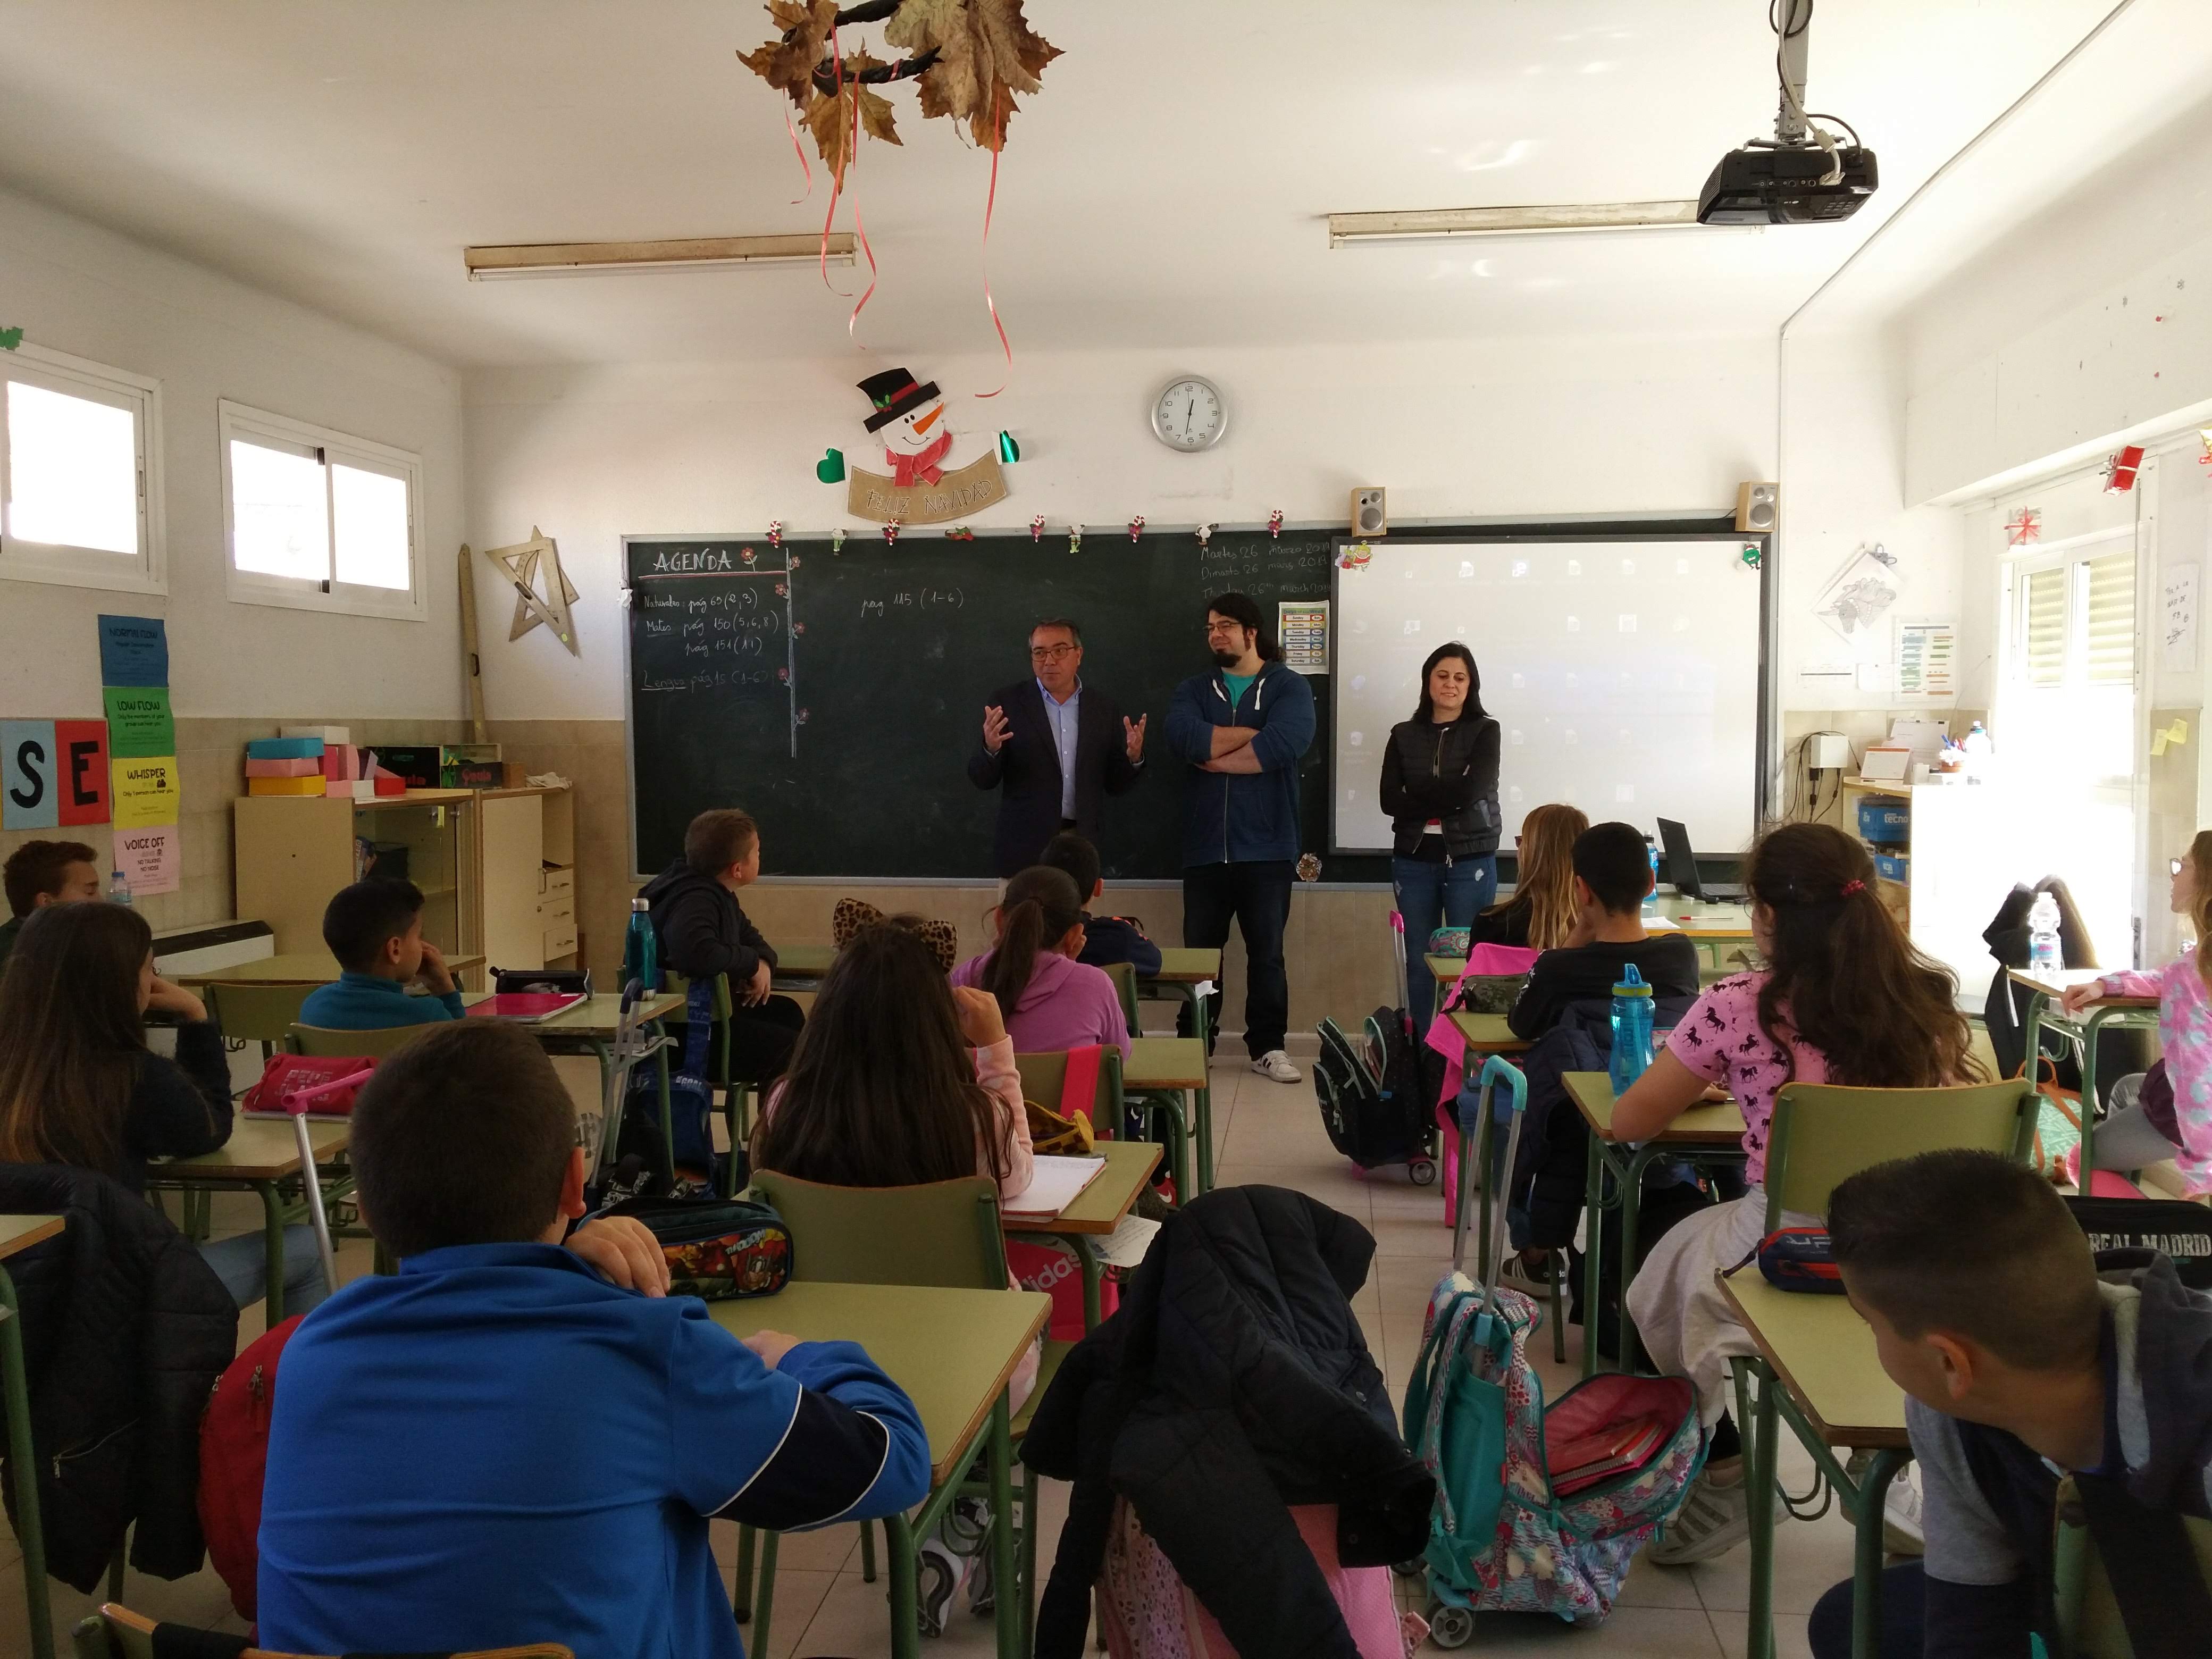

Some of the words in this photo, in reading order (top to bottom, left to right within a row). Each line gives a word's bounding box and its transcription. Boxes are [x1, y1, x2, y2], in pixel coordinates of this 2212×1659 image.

[867, 489, 910, 515] FELIZ
[924, 479, 992, 515] NAVIDAD
[653, 548, 732, 572] AGENDA
[1201, 546, 1237, 560] Martes
[1240, 544, 1258, 558] 26
[1201, 567, 1239, 580] Dimarts
[1243, 564, 1259, 574] 26
[1298, 555, 1327, 567] 2019
[689, 597, 707, 614] pág
[893, 593, 912, 606] 115
[140, 630, 158, 639] FLOW
[684, 617, 704, 637] pág
[685, 640, 709, 657] pág
[643, 670, 685, 691] Lengua
[116, 701, 136, 710] LOW
[137, 701, 160, 710] FLOW
[127, 768, 166, 780] WHISPER
[1884, 812, 1911, 824] tecno
[124, 838, 149, 850] VOICE
[151, 836, 165, 848] OFF
[284, 1070, 333, 1086] PEPE
[2088, 1233, 2130, 1252] REAL
[2141, 1234, 2212, 1257] MADRID
[1022, 1251, 1082, 1292] idas
